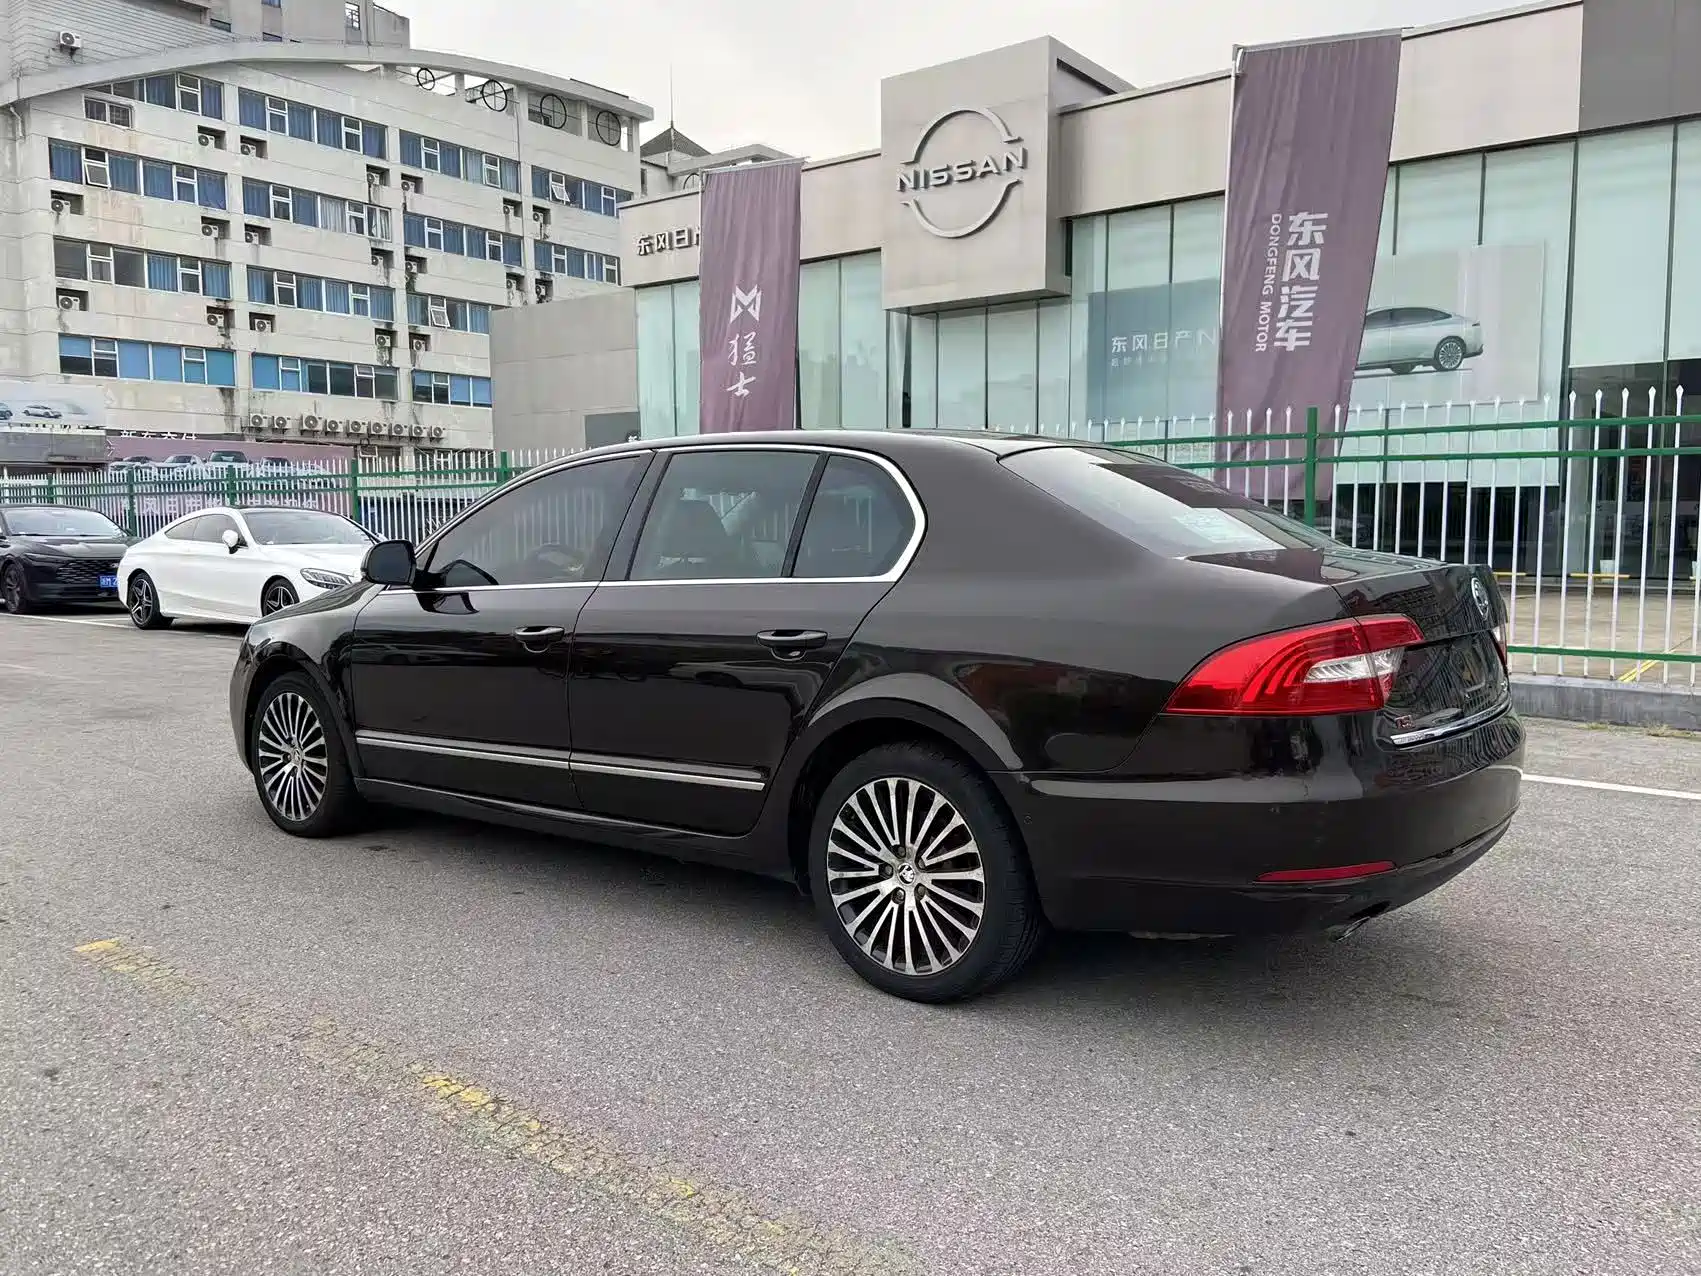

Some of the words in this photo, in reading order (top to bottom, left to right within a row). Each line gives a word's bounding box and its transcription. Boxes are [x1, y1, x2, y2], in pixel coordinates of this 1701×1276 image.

[896, 146, 1028, 192] NISSAN
[1262, 213, 1282, 296] DONGFENG
[1274, 211, 1328, 351] 东风汽车
[1255, 301, 1273, 352] MOTOR
[727, 331, 757, 397] 猛士
